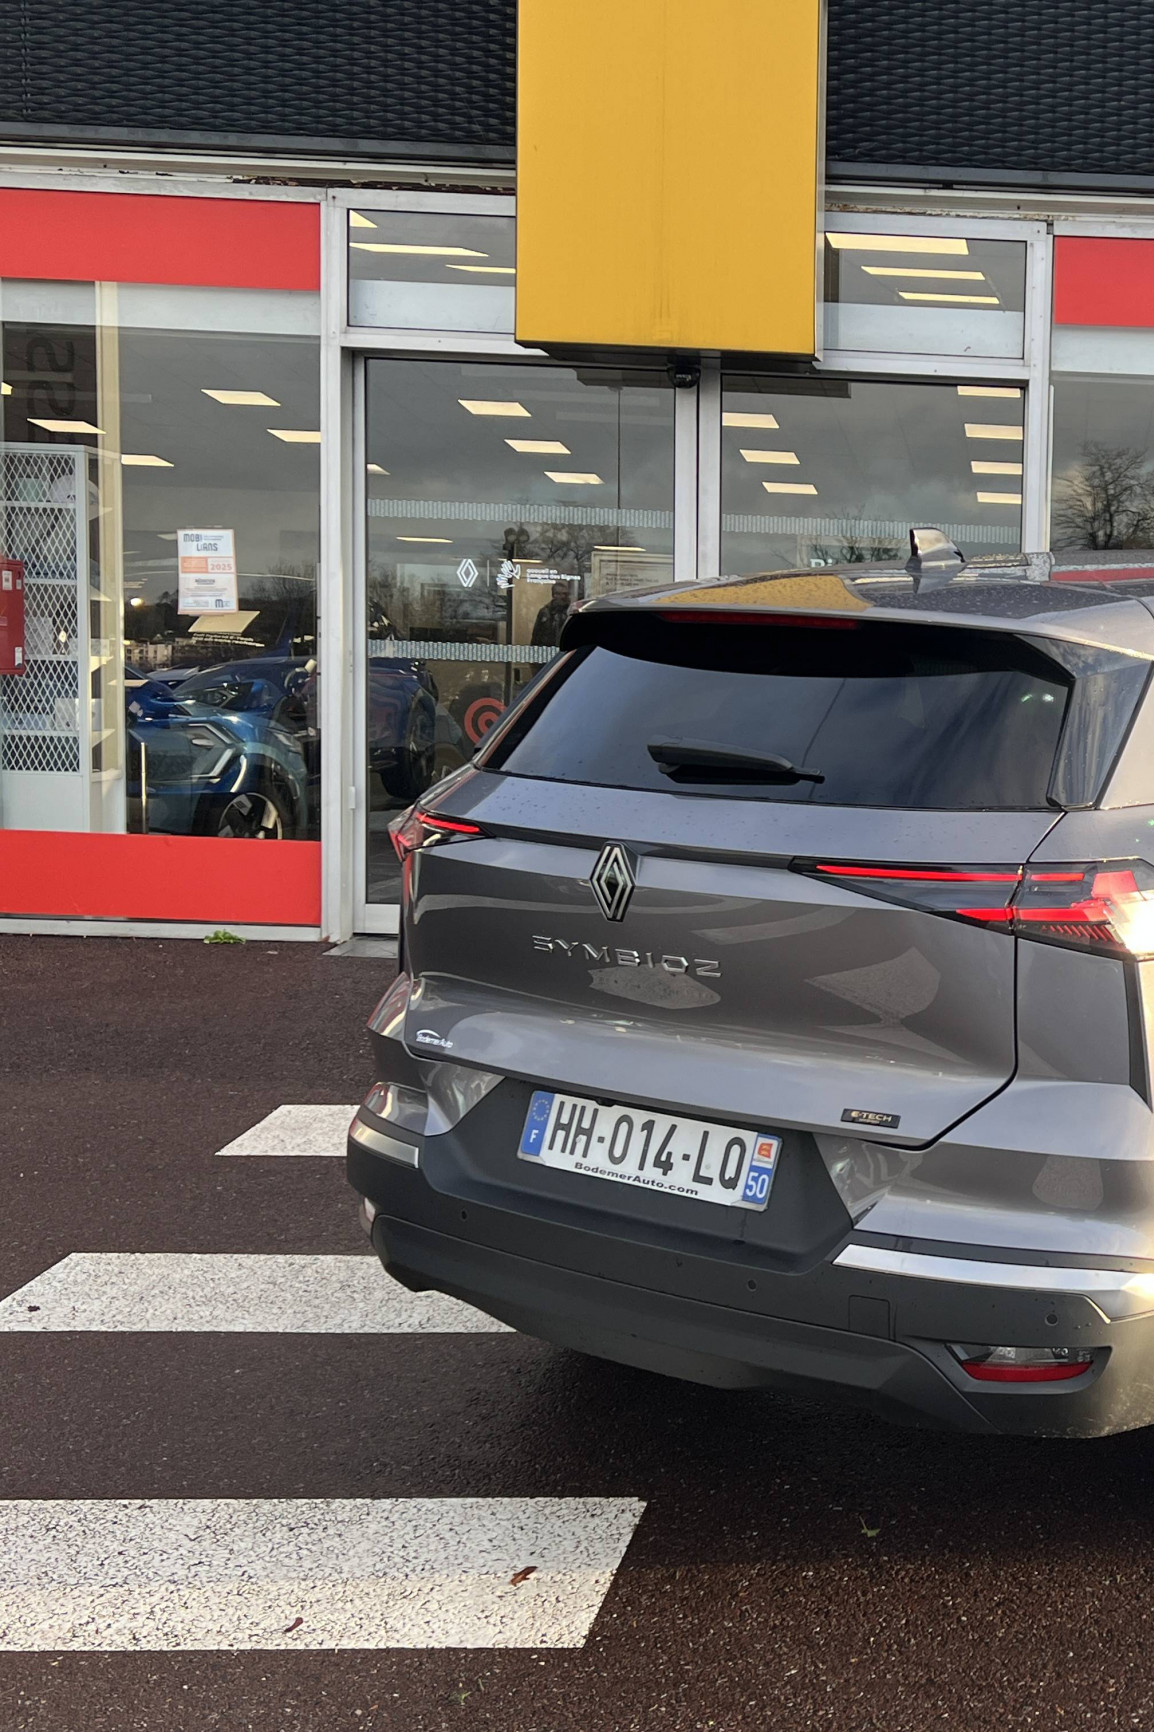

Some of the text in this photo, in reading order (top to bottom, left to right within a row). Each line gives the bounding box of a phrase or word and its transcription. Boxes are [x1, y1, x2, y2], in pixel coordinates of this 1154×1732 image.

[210, 562, 233, 571] 2025
[532, 934, 722, 978] SYMBIOZ
[529, 1129, 540, 1144] F
[547, 1100, 748, 1191] HH-014-LQ
[573, 1160, 700, 1198] BodemerAuto.com
[745, 1171, 770, 1200] 50
